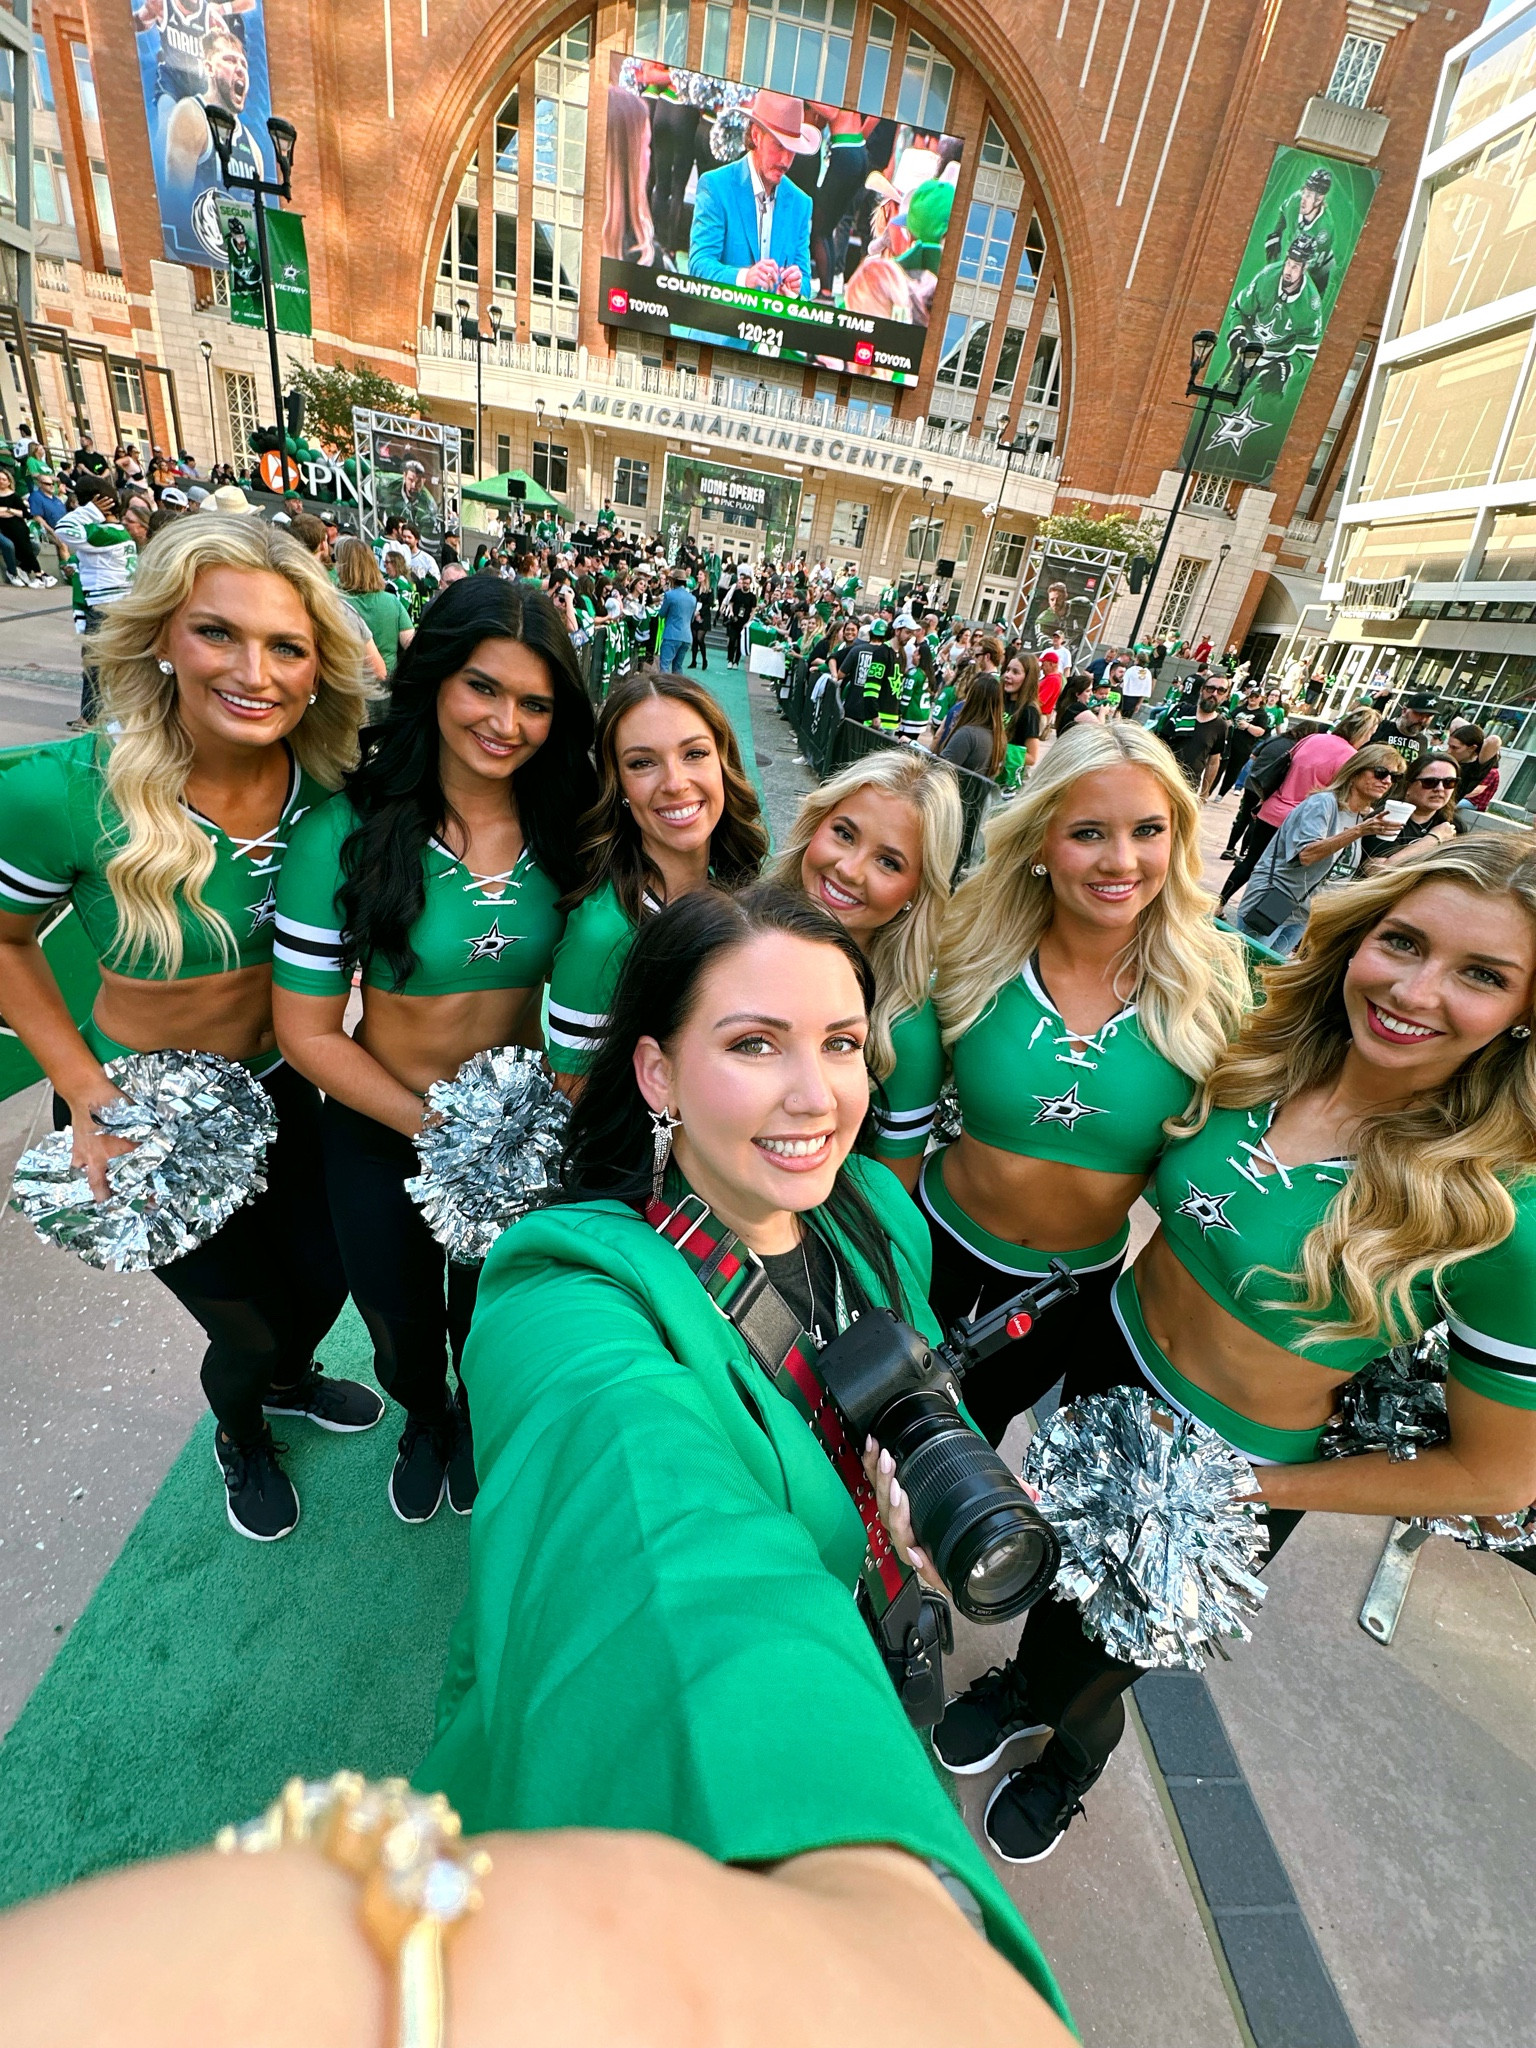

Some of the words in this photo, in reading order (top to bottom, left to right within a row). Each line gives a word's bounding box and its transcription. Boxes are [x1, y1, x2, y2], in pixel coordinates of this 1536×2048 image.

[219, 205, 253, 219] SEGUIN
[628, 298, 670, 318] TOYOTA
[656, 274, 758, 309] COUNTDOWN
[761, 297, 784, 314] TO
[787, 303, 834, 325] GAME
[837, 313, 876, 334] TIME
[737, 322, 784, 346] 120:21
[873, 350, 912, 369] TOYOTA
[700, 477, 728, 497] HOME
[728, 482, 766, 504] OPENER
[720, 498, 735, 509] PNC
[735, 501, 756, 512] PLAZA
[1388, 735, 1408, 747] BEST
[1408, 739, 1420, 752] DAD
